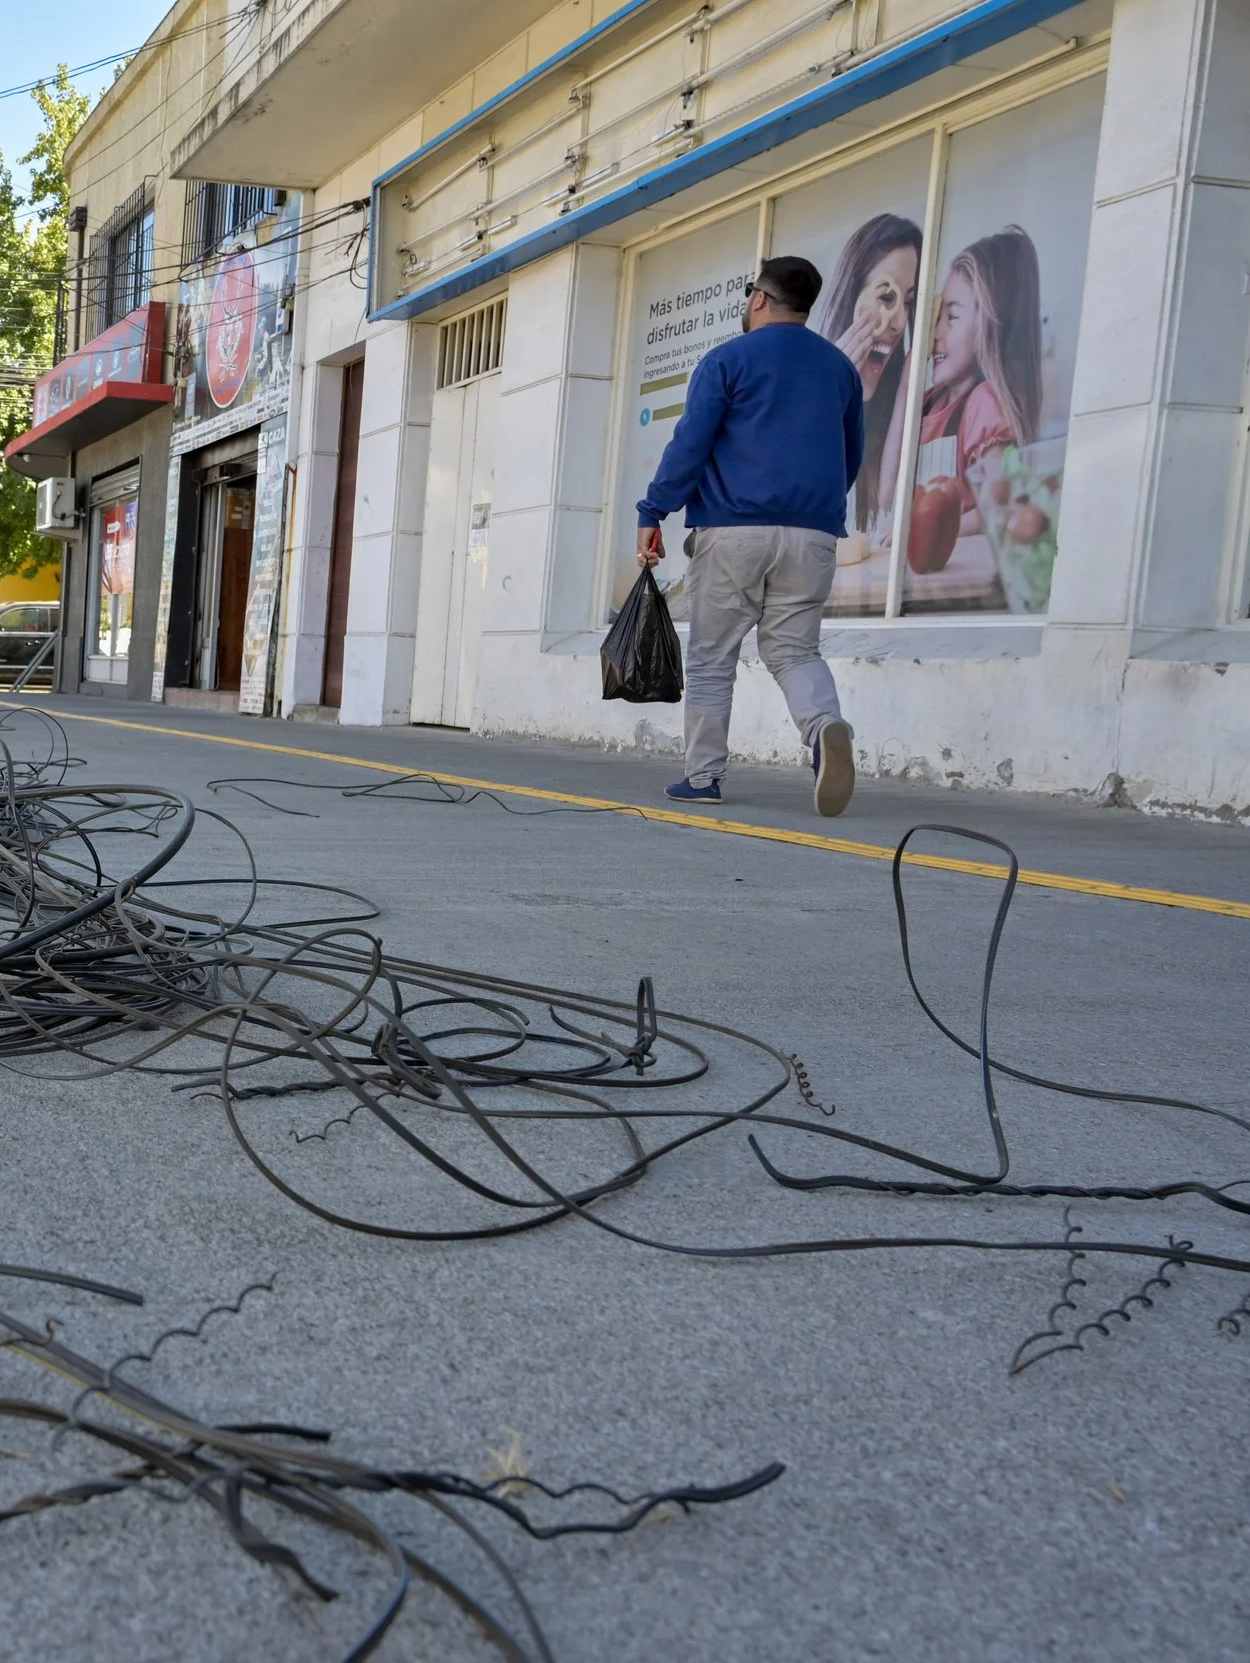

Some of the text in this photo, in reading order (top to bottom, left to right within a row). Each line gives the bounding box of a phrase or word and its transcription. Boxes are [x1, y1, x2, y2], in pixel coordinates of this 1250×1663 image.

[650, 298, 672, 319] Más
[676, 283, 722, 310] tiempo
[646, 316, 699, 345] disfrutar
[703, 310, 714, 328] la
[644, 352, 670, 366] Compra
[672, 347, 683, 358] tus
[683, 341, 705, 354] bonos
[687, 358, 695, 367] tu
[268, 427, 286, 444] CAZA
